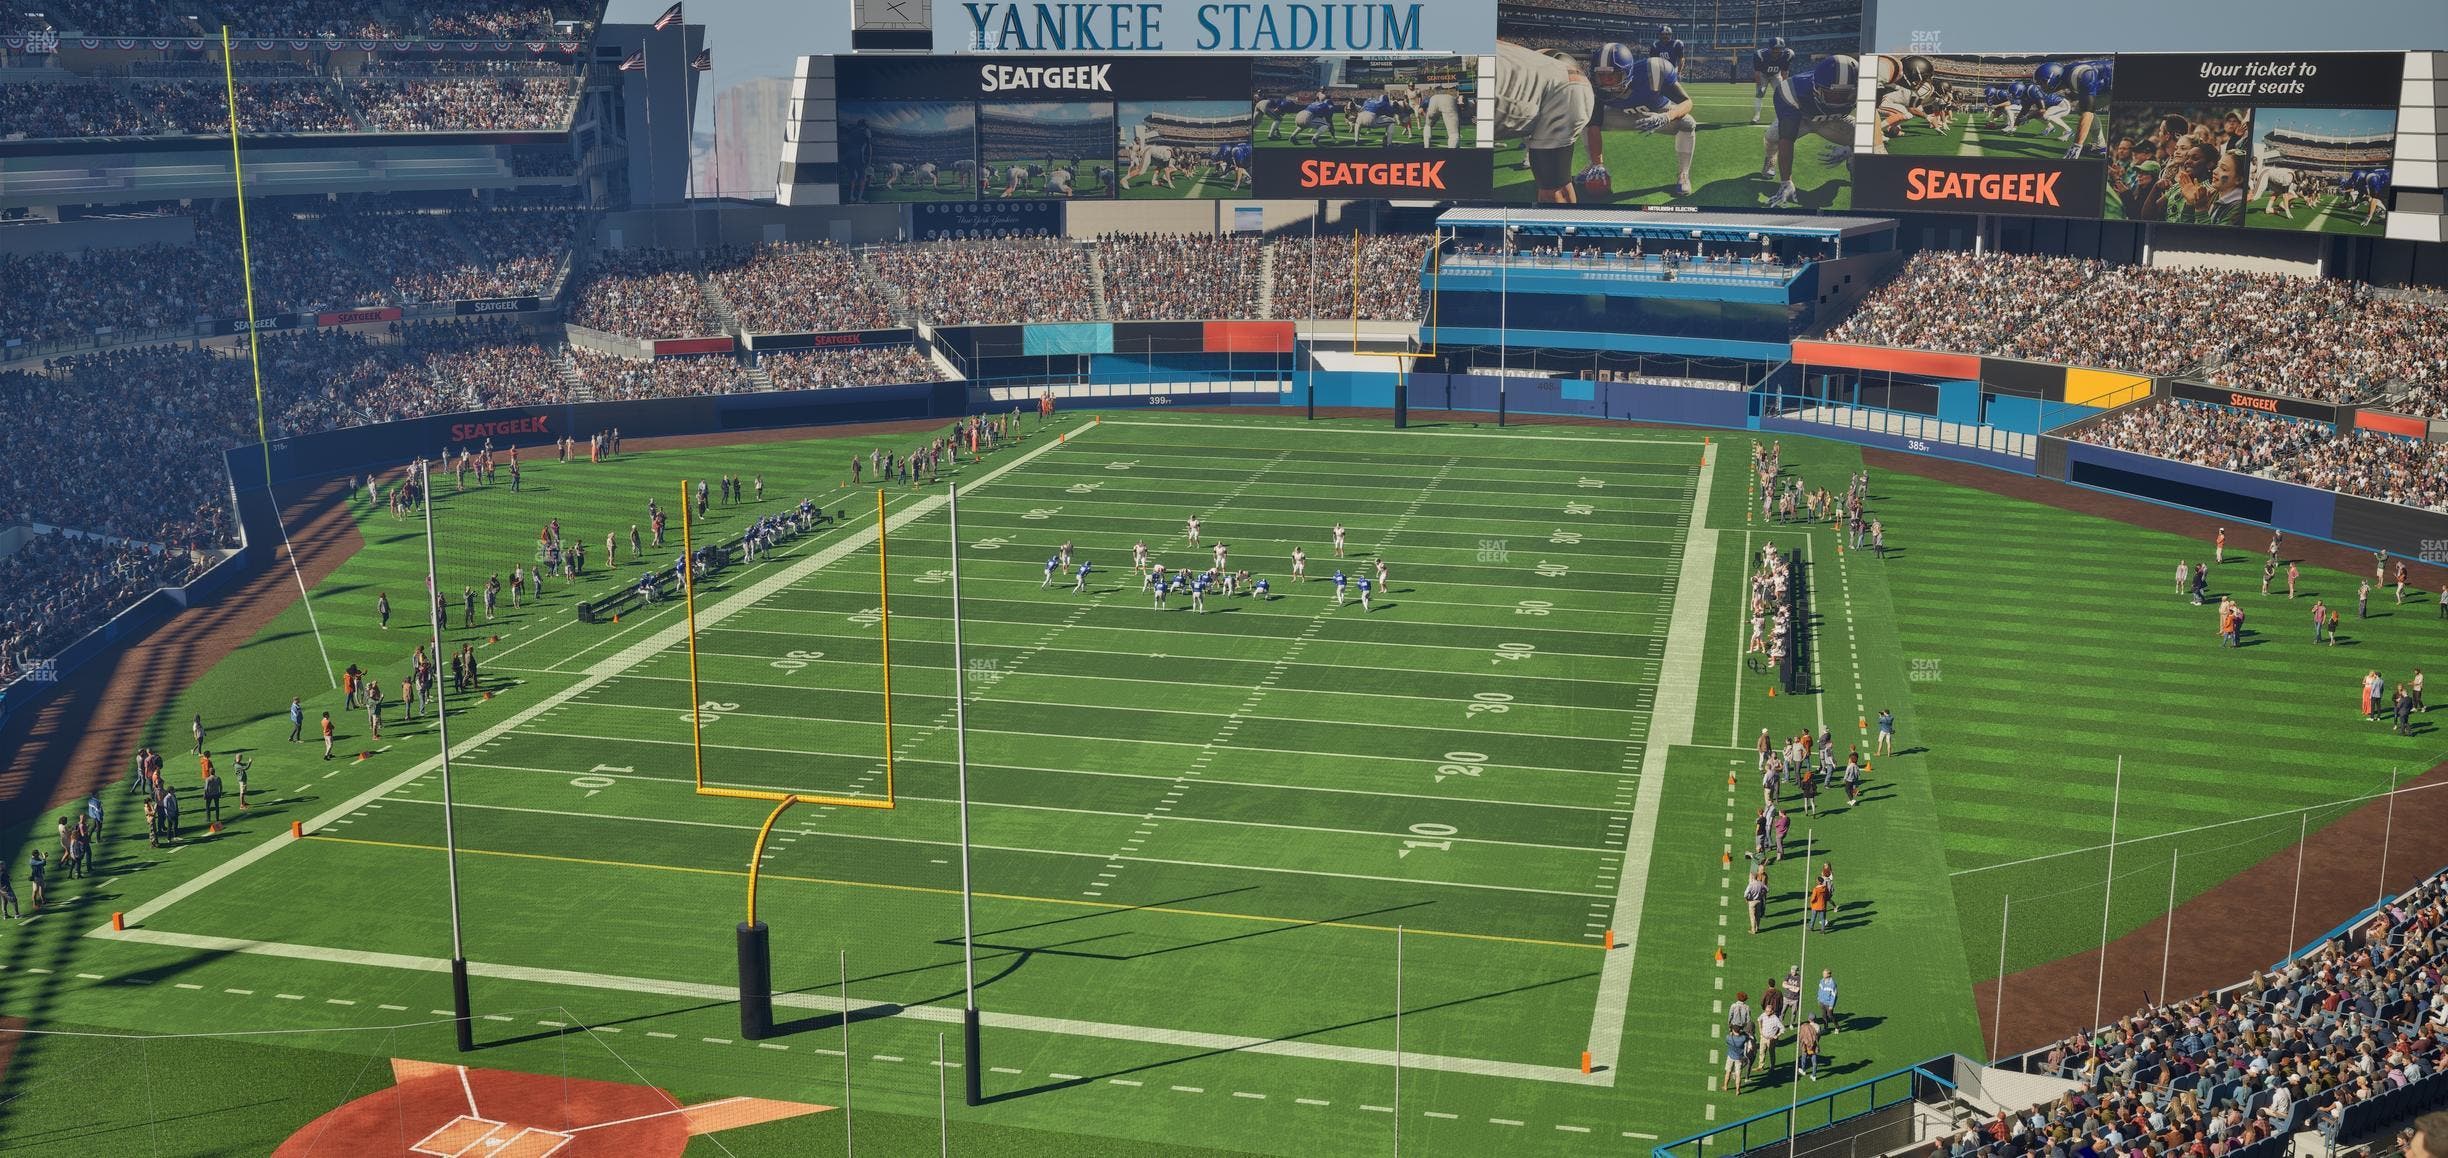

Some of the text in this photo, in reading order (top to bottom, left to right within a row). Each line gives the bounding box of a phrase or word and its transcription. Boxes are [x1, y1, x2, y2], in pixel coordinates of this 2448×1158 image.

[963, 3, 1424, 50] YANKEE STADIUM
[981, 64, 1112, 92] SEATGEEK
[2200, 62, 2317, 78] Your ticket to
[2208, 80, 2305, 97] great seats
[1301, 160, 1446, 189] SEATGEEK
[1906, 167, 2062, 207] SEATGEEK
[475, 301, 518, 312] SEATGEEK
[234, 317, 277, 332] SEAGEEK
[338, 311, 382, 323] SEATGEEK
[815, 333, 861, 345] SEATGEEK
[2230, 393, 2277, 412] SEATGEEK
[452, 416, 548, 442] SEATGEEK
[1514, 600, 1554, 616] 50
[770, 650, 824, 669] 30
[1495, 642, 1536, 660] 40
[1467, 692, 1514, 713] 30
[1437, 751, 1489, 777] 20
[570, 764, 634, 788] 10
[1403, 822, 1458, 851] 10
